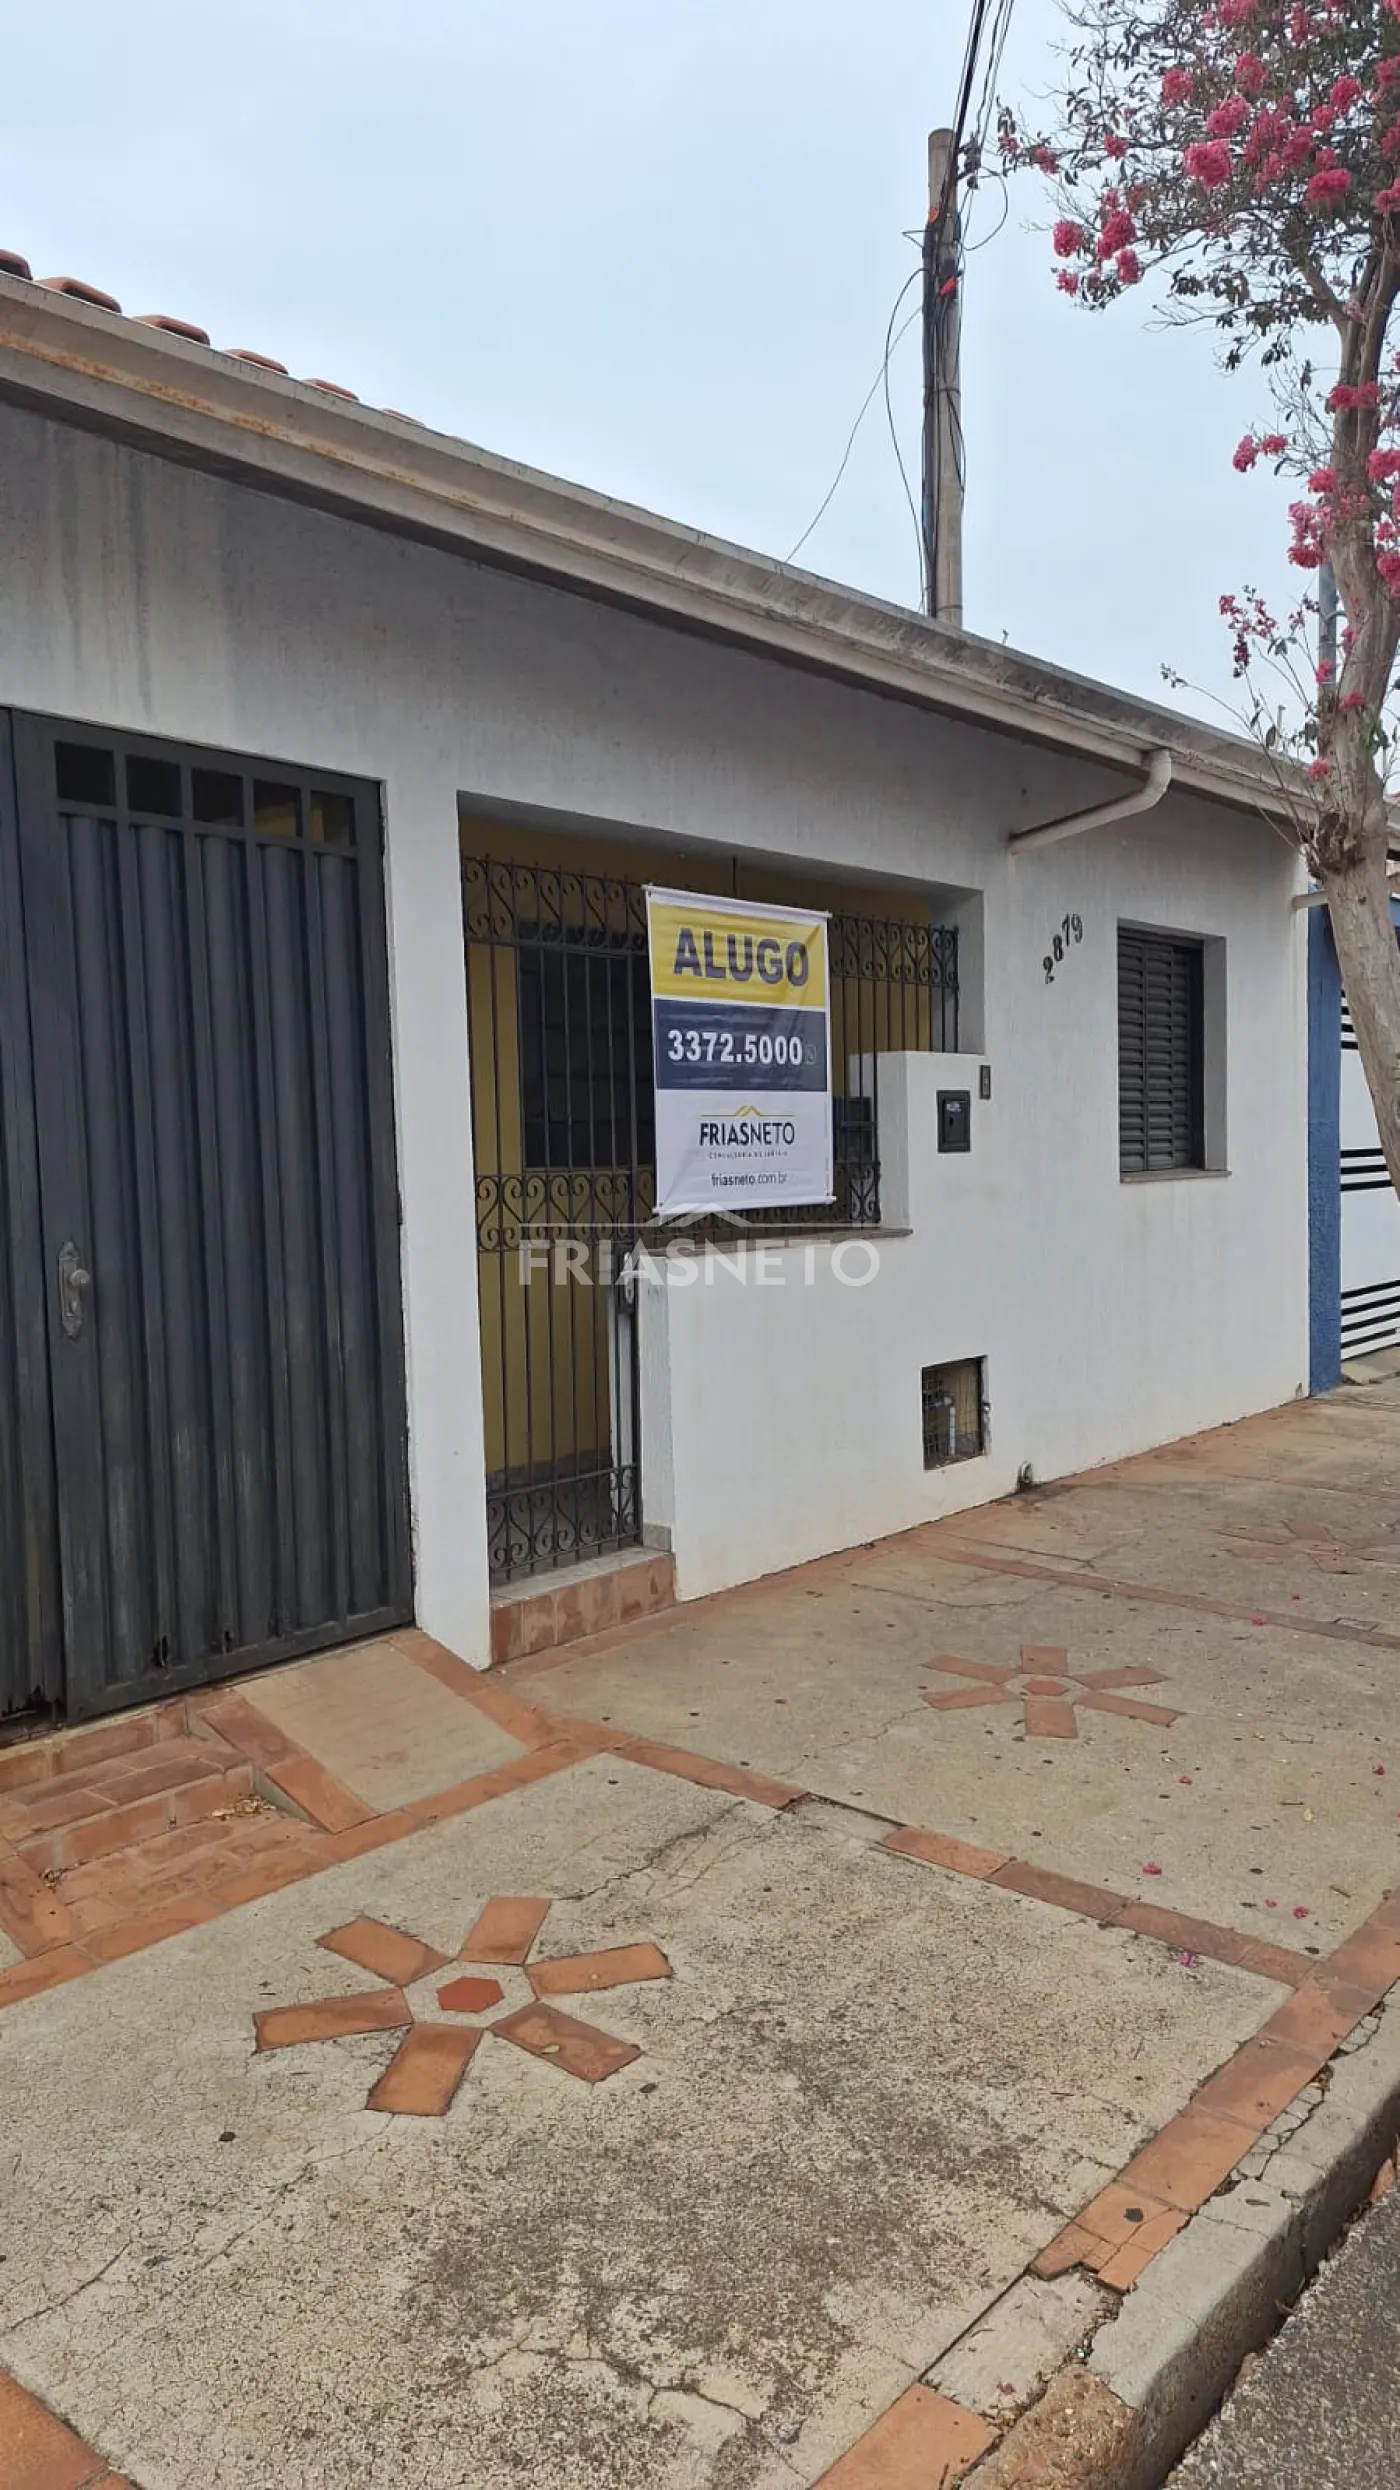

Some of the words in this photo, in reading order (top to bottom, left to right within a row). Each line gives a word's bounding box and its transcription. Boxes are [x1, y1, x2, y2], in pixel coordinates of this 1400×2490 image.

[673, 927, 809, 987] ALUGO
[667, 1029, 802, 1066] 3372.5000
[699, 1122, 795, 1147] FRIASNETO
[711, 1171, 788, 1187] friasneto.com.br
